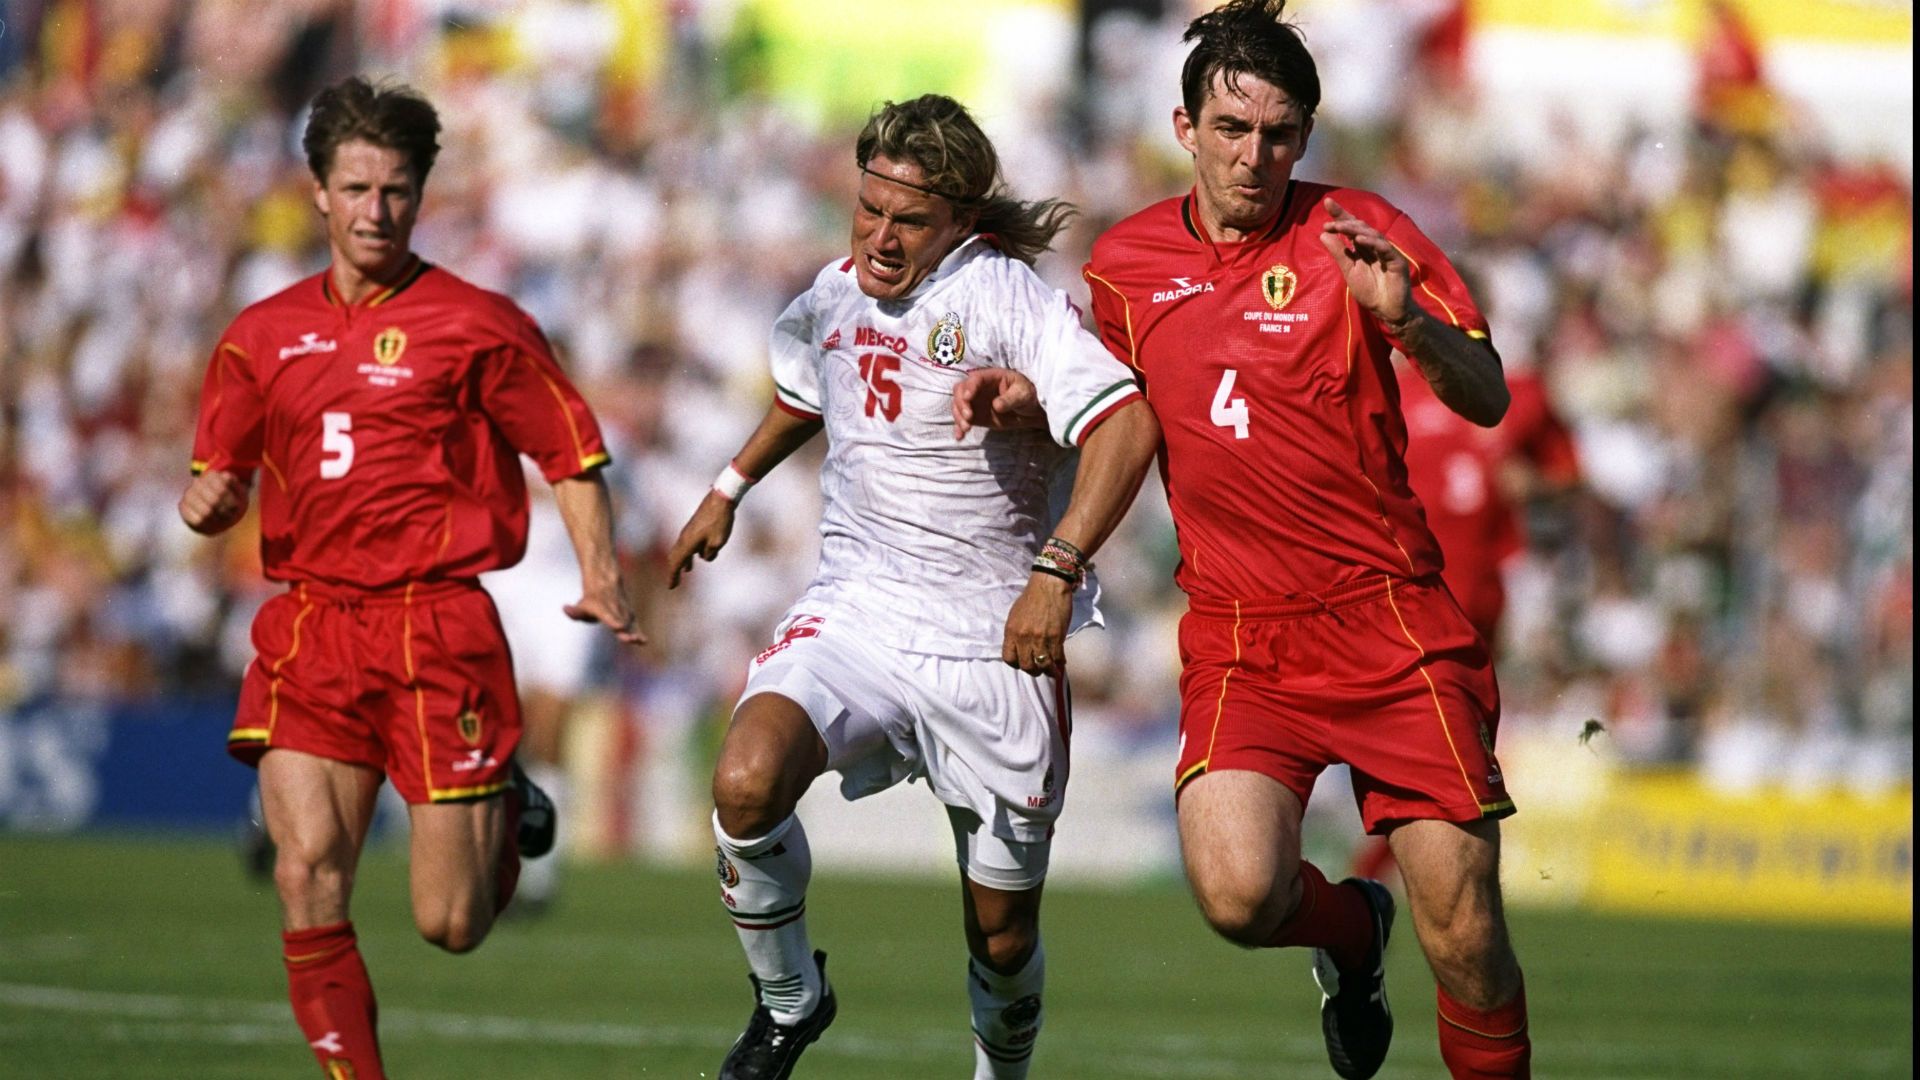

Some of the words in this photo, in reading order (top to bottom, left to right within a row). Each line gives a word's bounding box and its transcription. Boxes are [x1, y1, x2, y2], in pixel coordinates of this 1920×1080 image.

[1152, 282, 1215, 303] DIADORA
[1243, 311, 1263, 321] COUPE
[1263, 312, 1273, 321] DU
[1273, 313, 1296, 322] MONDE
[1296, 313, 1309, 322] FIFA
[1259, 323, 1282, 333] FRANCE
[854, 327, 908, 354] MEXCO
[858, 353, 902, 423] 15
[1210, 368, 1250, 439] 4
[320, 412, 354, 480] 5
